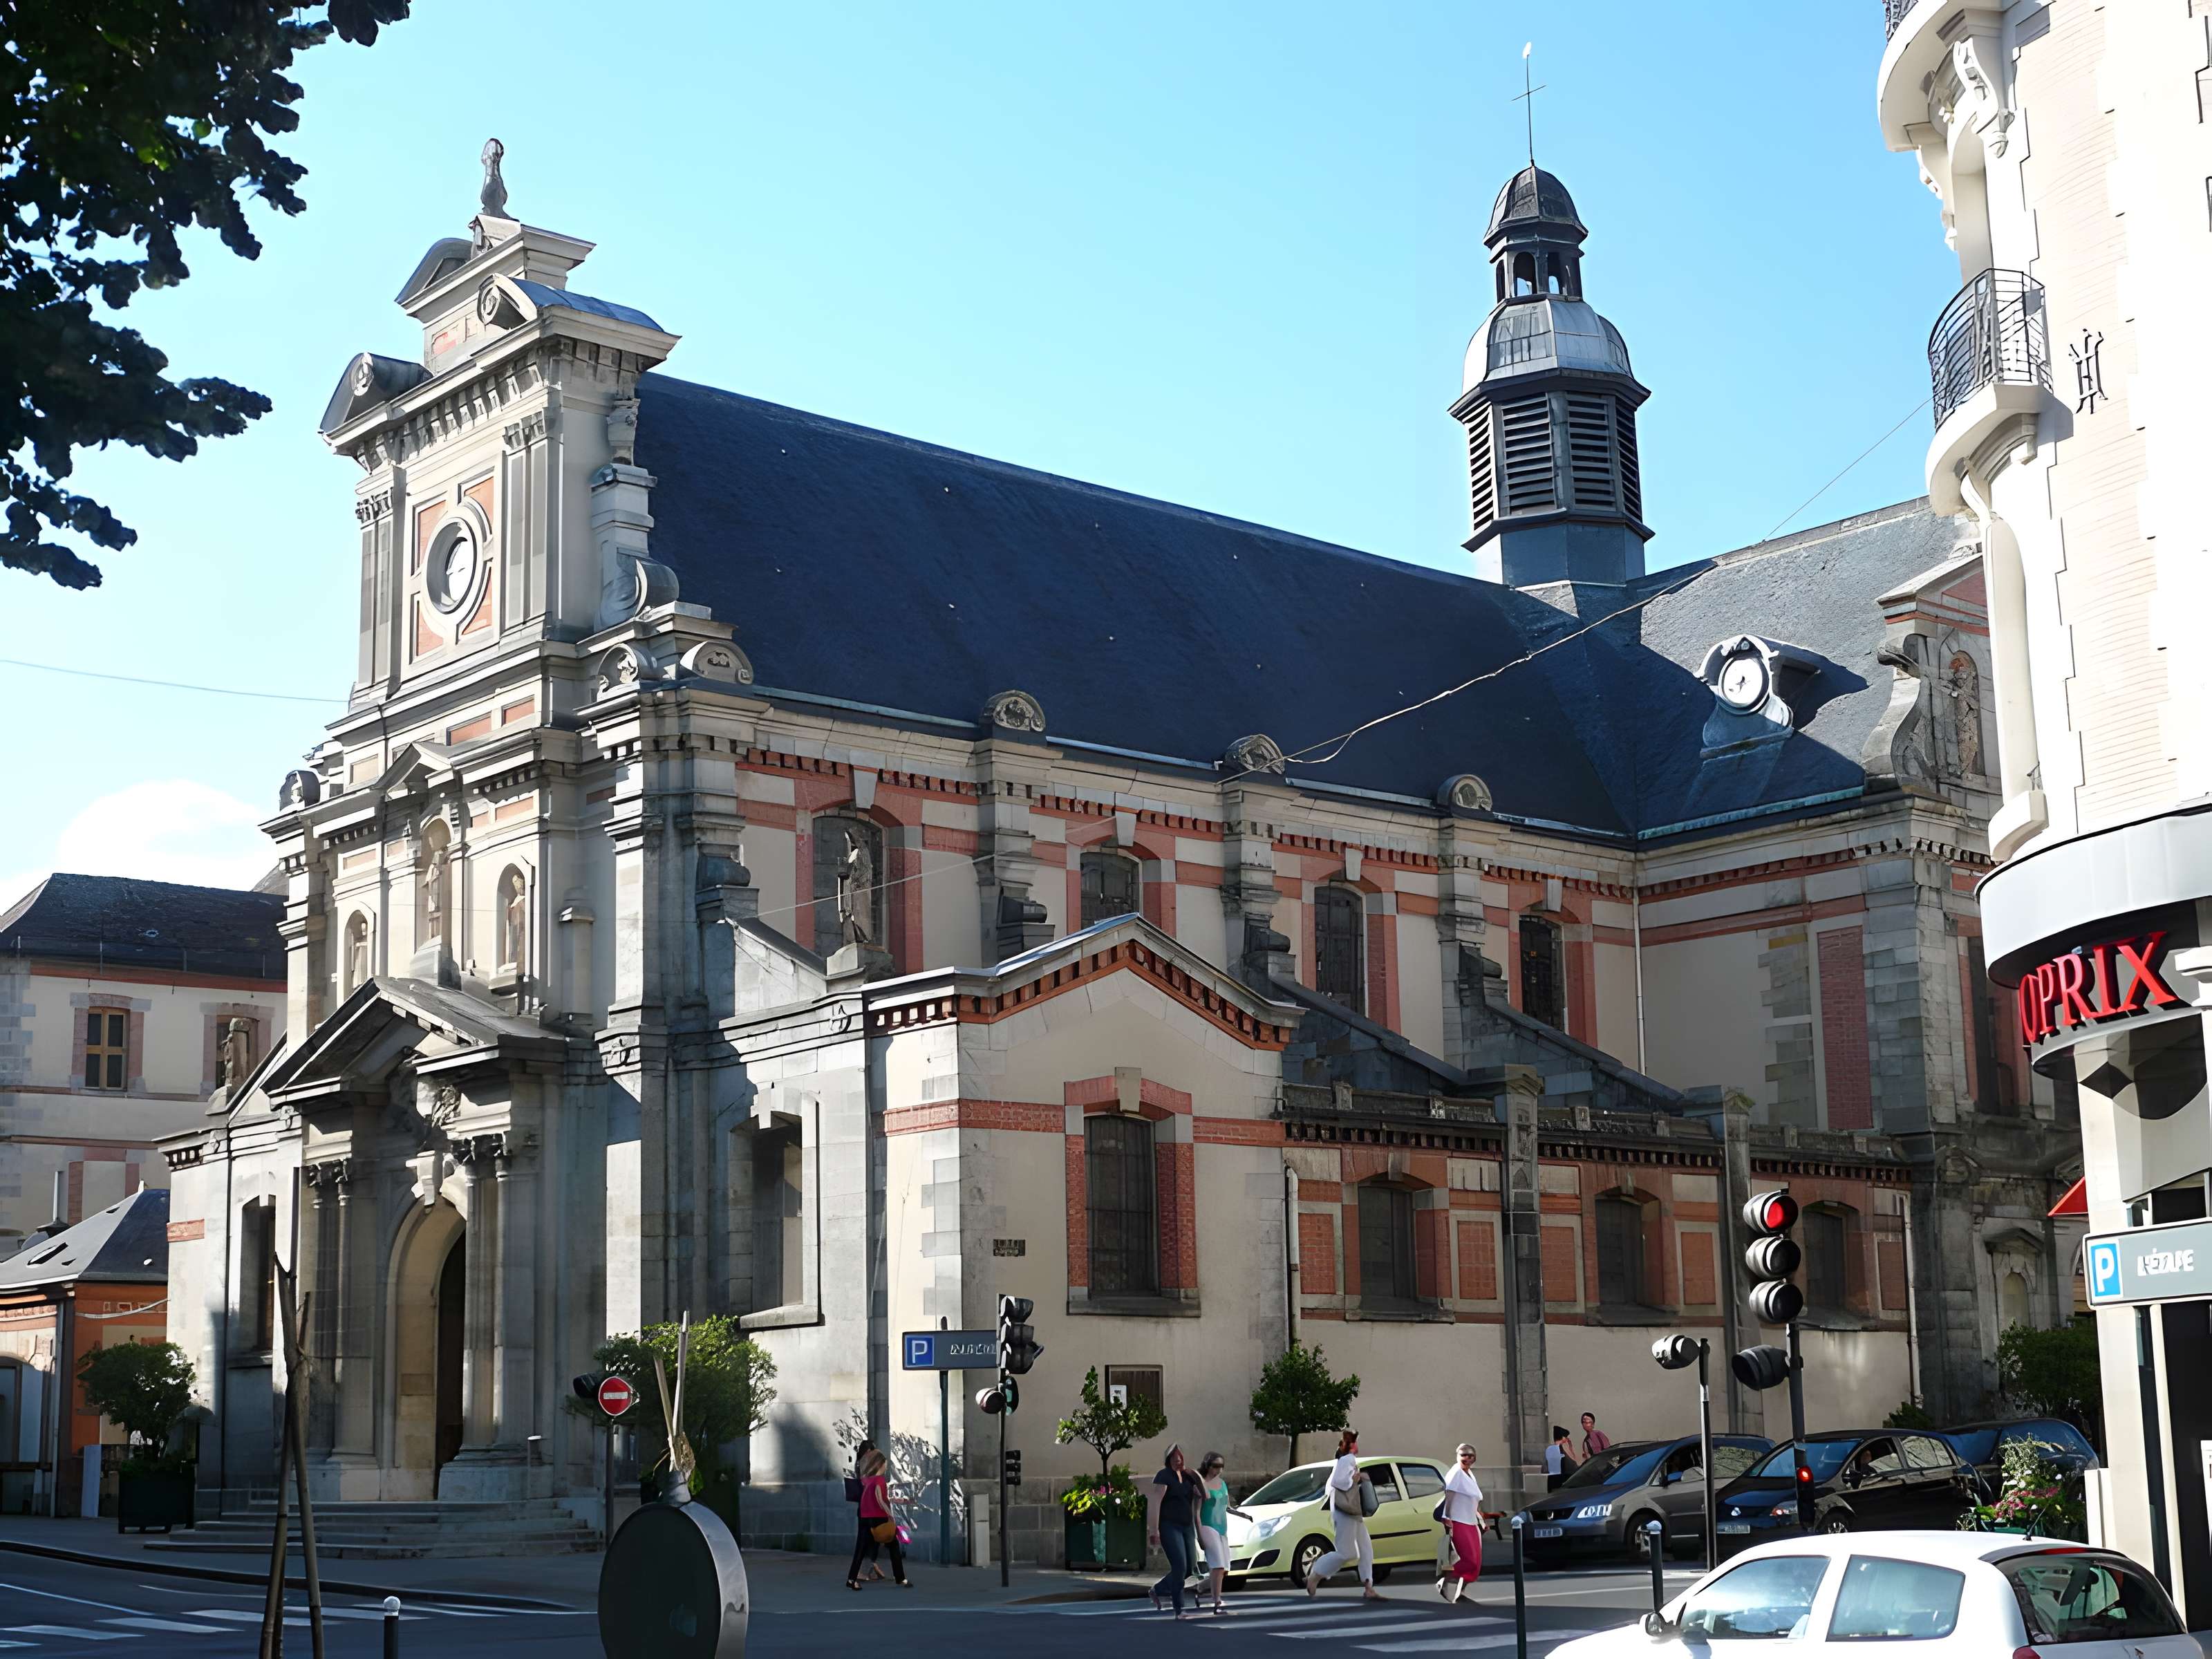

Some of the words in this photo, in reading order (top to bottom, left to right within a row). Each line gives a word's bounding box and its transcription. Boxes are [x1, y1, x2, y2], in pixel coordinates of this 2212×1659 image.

[2018, 932, 2178, 1043] OPRIX
[2094, 1248, 2115, 1293] P
[912, 1340, 928, 1364] P
